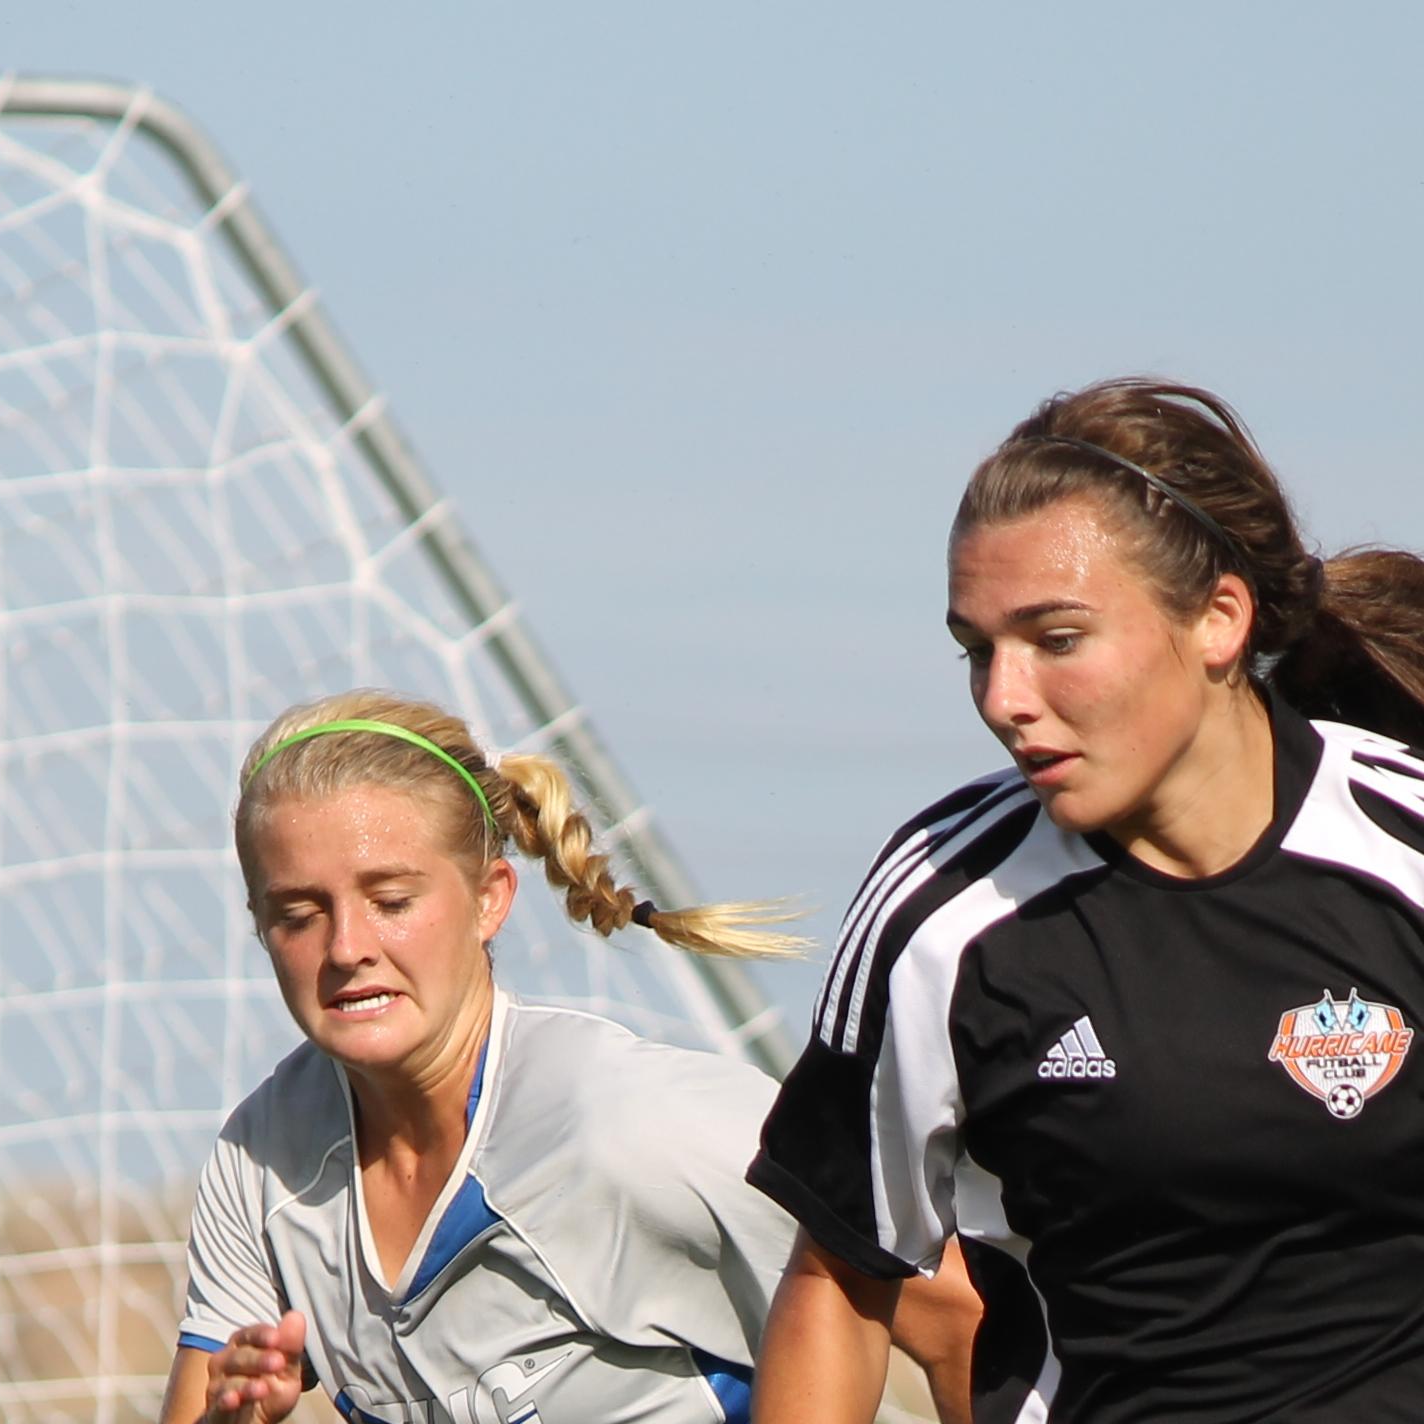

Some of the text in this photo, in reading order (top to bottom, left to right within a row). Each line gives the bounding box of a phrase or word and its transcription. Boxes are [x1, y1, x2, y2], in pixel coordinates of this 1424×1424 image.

[1270, 1030, 1414, 1059] HURRICANE
[1037, 1056, 1117, 1078] adidas
[1305, 1056, 1382, 1069] FUTBALL
[1323, 1068, 1367, 1079] CLUB
